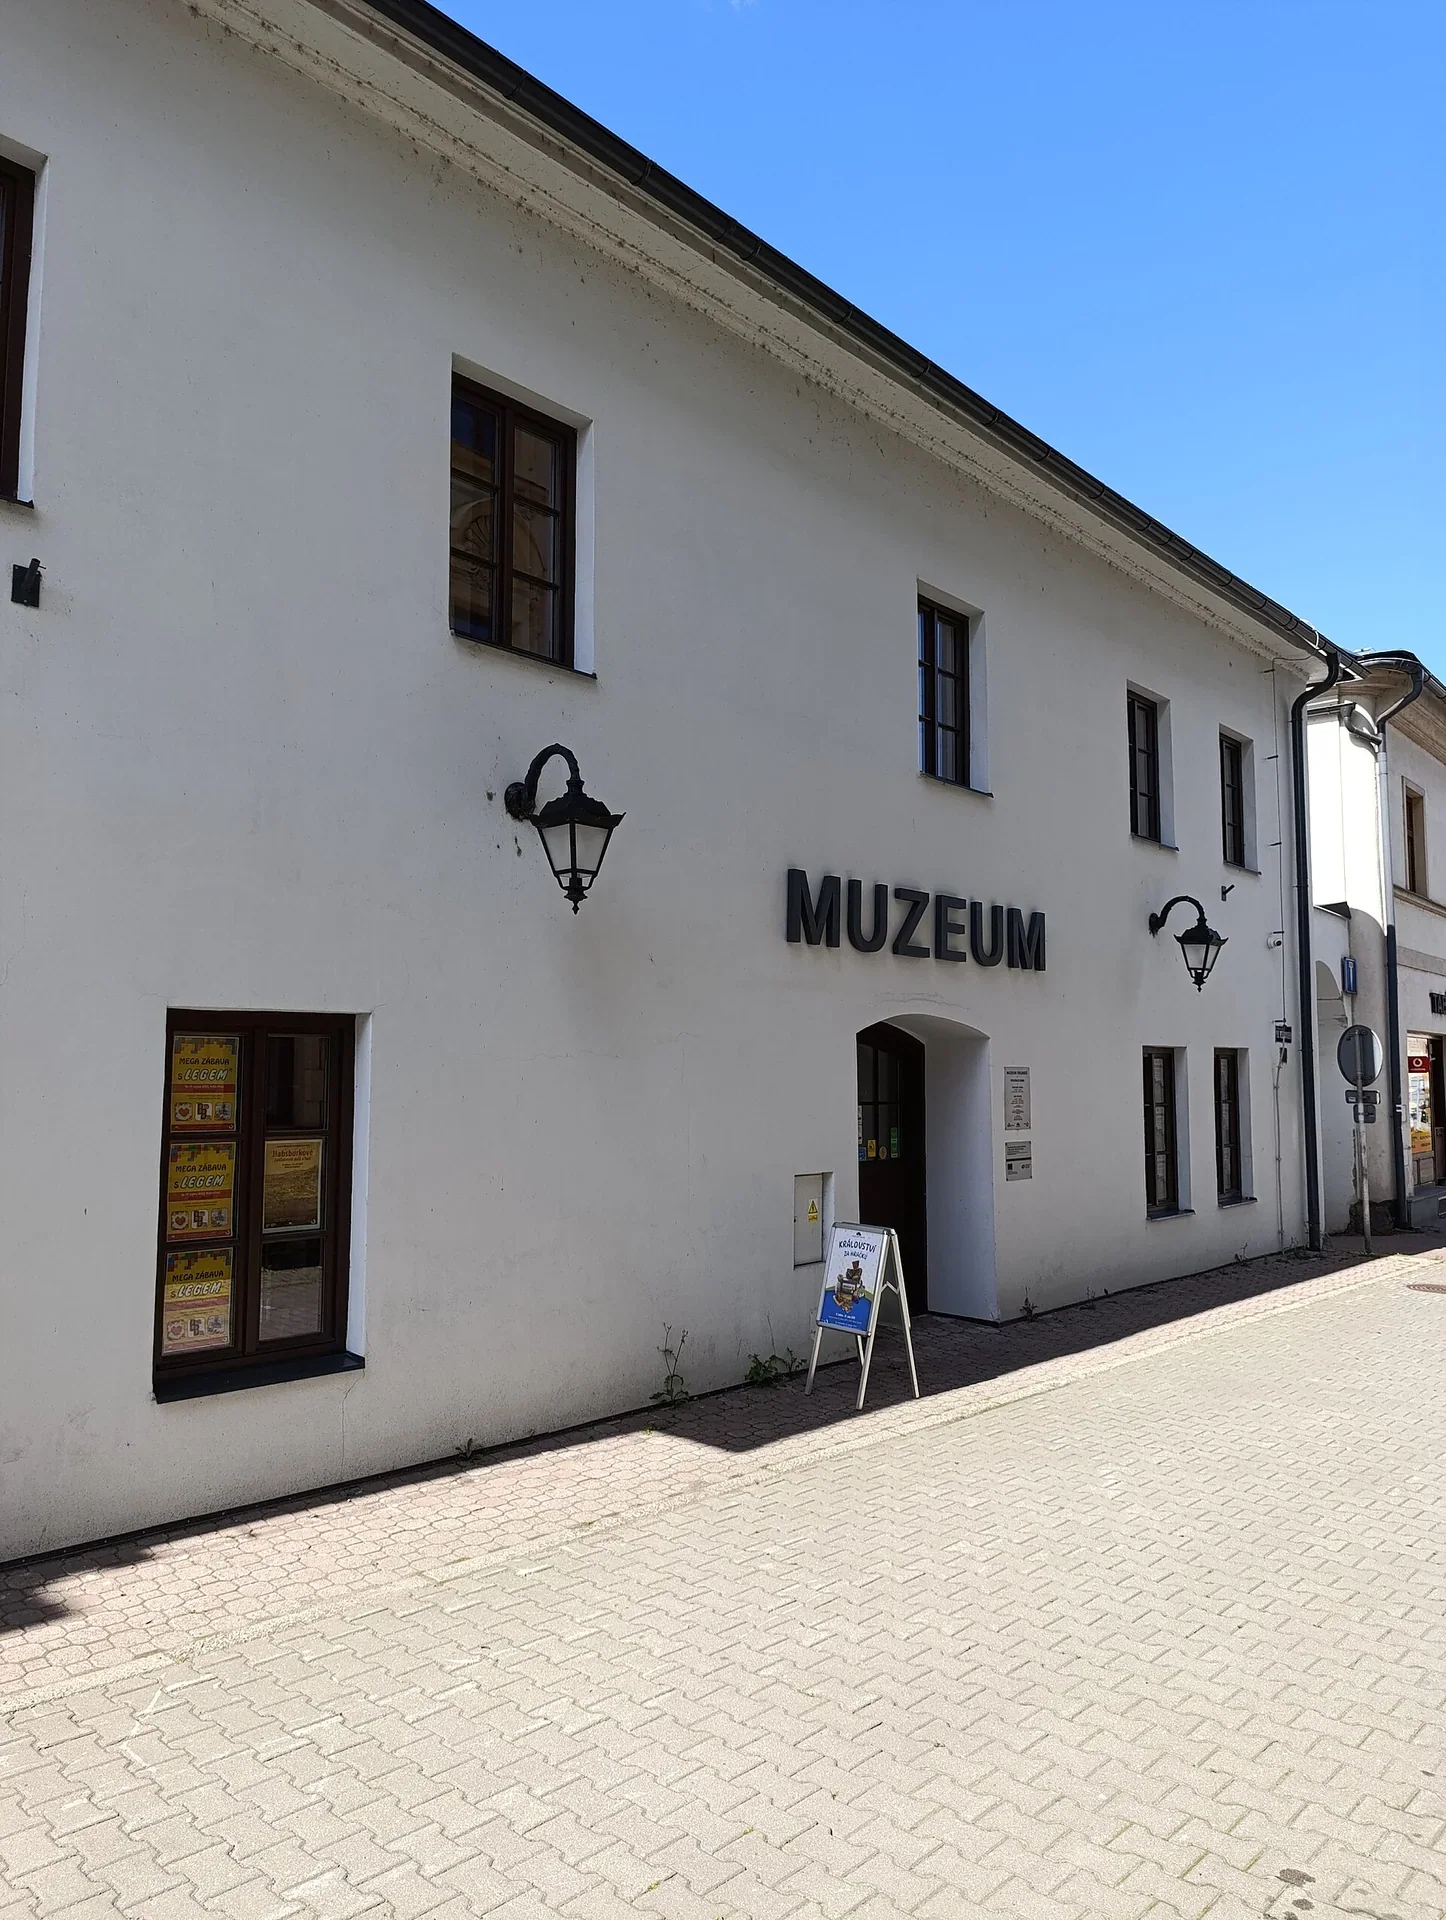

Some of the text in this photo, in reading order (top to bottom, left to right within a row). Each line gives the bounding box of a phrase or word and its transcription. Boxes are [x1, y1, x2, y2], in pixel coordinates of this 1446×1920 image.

[787, 868, 1047, 972] MUZEUM
[178, 1056, 230, 1065] MEGA ZÁBAVA
[184, 1067, 229, 1081] LEGEM
[175, 1162, 227, 1173] MEGA ZÁBAVA
[180, 1174, 225, 1189] LEGEM
[838, 1239, 877, 1254] KRÁLOVSTVÍ
[172, 1270, 224, 1282] MEGA ZÁBAVA
[177, 1281, 223, 1298] LEGEM
